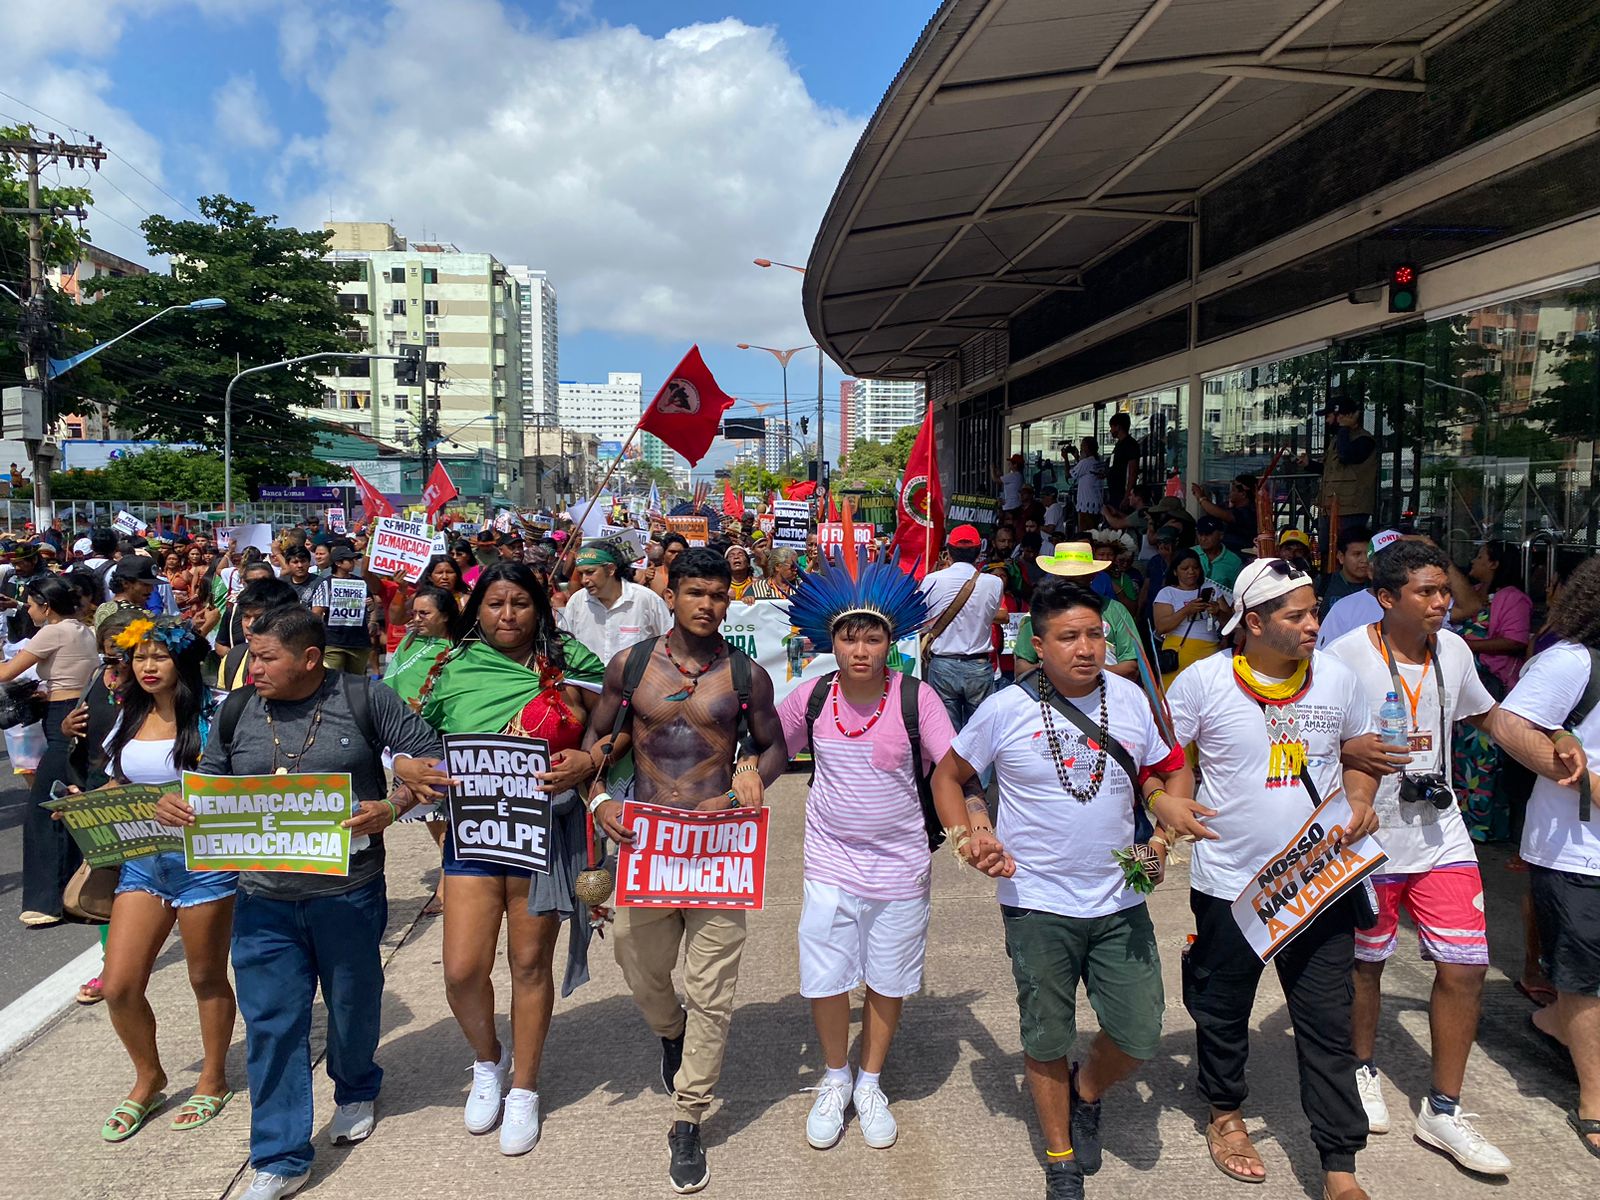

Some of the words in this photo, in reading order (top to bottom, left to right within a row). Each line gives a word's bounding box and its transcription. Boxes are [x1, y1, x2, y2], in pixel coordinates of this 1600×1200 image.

[775, 510, 809, 520] DEMARCAÇÃO
[865, 508, 893, 523] LIVRE
[948, 506, 993, 523] AMAZÔNIA
[383, 519, 422, 536] SEMPRE
[775, 528, 808, 540] JUSTIÇA
[1378, 534, 1400, 545] CONTA
[333, 587, 363, 599] SEMPRE
[331, 607, 360, 618] AQUI
[723, 624, 756, 633] DOS
[449, 749, 547, 778] MARCO
[451, 774, 549, 802] TEMPORAL
[188, 789, 345, 816] DEMARCAÇÃO
[497, 798, 510, 817] É
[64, 808, 99, 830] FIM
[92, 804, 133, 824] DOS
[261, 812, 277, 831] É
[88, 824, 119, 847] NA
[191, 831, 343, 857] DEMOCRACIA
[457, 819, 546, 856] GOLPE
[631, 816, 650, 851] O
[655, 819, 758, 854] FUTURO
[1257, 822, 1325, 890] NOSSO
[626, 850, 643, 891] É
[648, 854, 755, 894] INDÍGENA
[1251, 824, 1345, 912] FUTURO
[1285, 845, 1366, 919] VENDA
